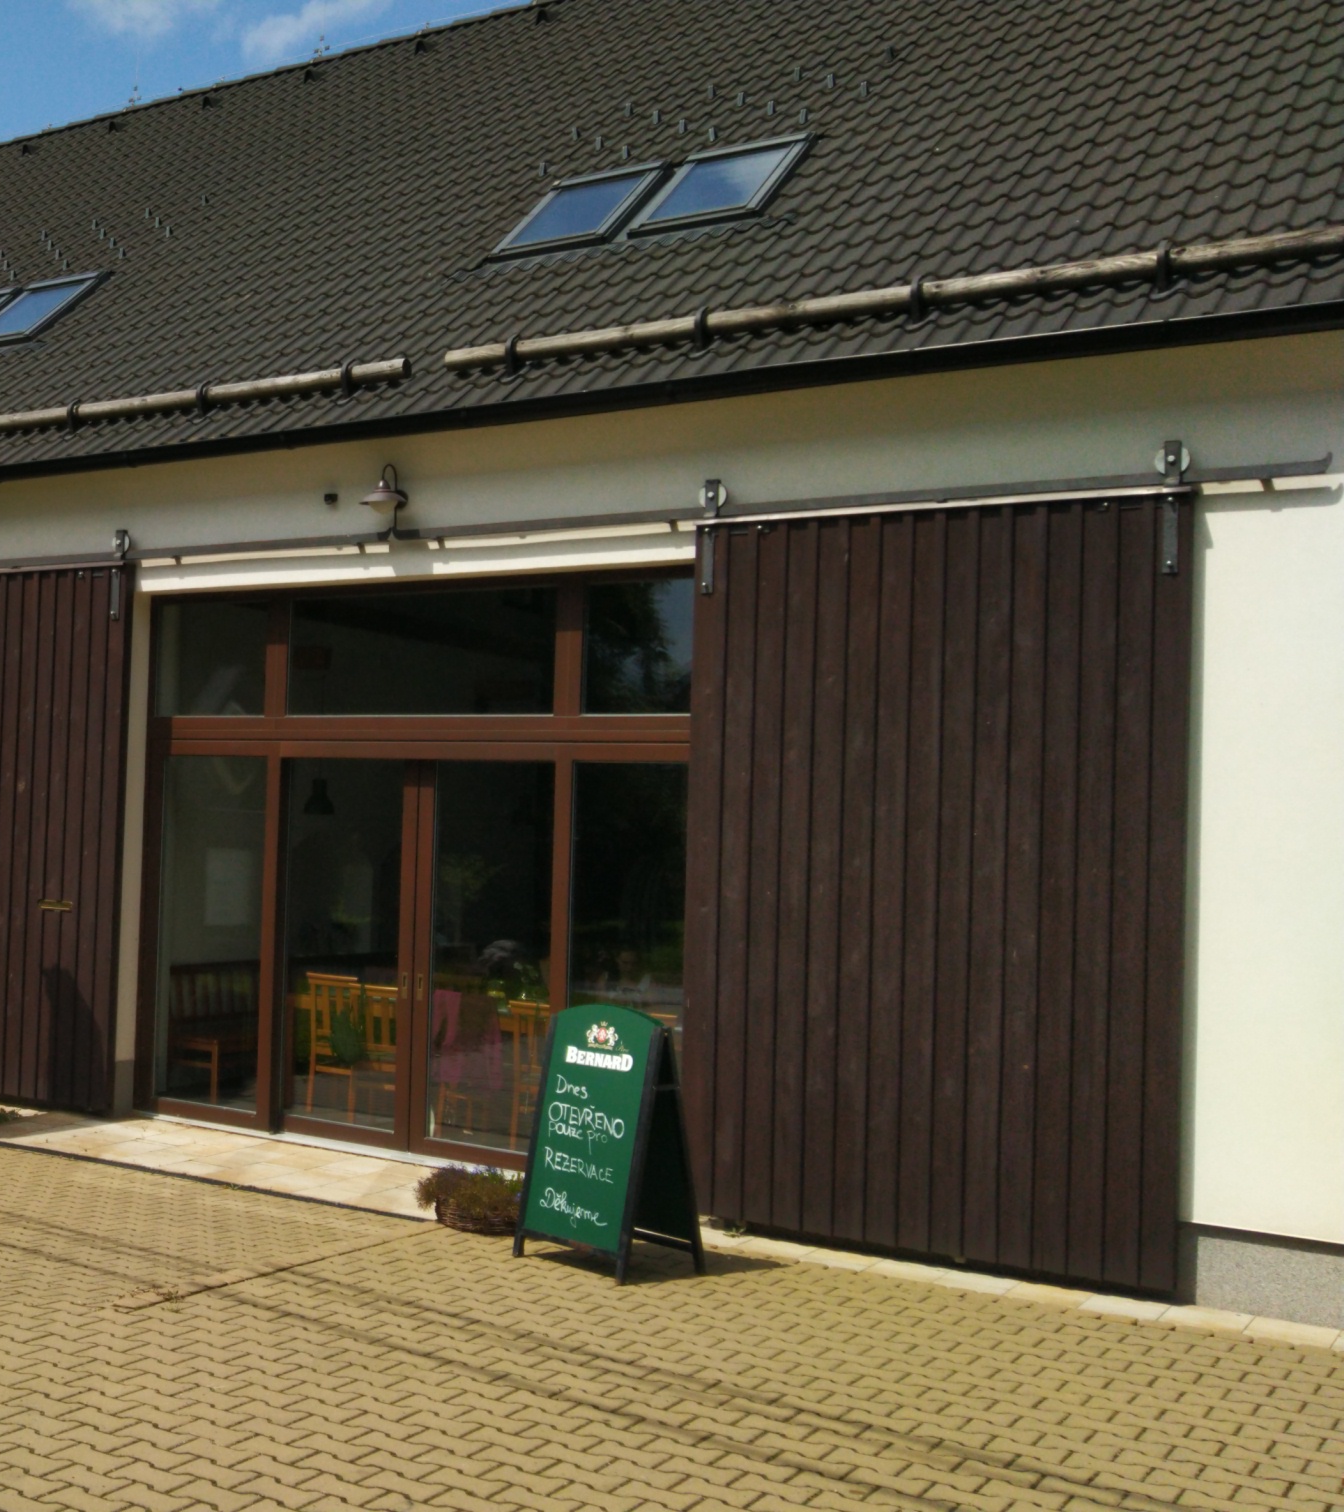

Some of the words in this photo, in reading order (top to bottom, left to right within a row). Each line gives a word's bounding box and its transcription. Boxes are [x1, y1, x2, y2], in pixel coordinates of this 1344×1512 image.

[565, 1045, 634, 1072] BERNARD
[555, 1074, 588, 1099] Dnes
[548, 1101, 625, 1139] OTEVŘENO
[587, 1130, 608, 1155] pro
[544, 1146, 614, 1184] REZERVACE
